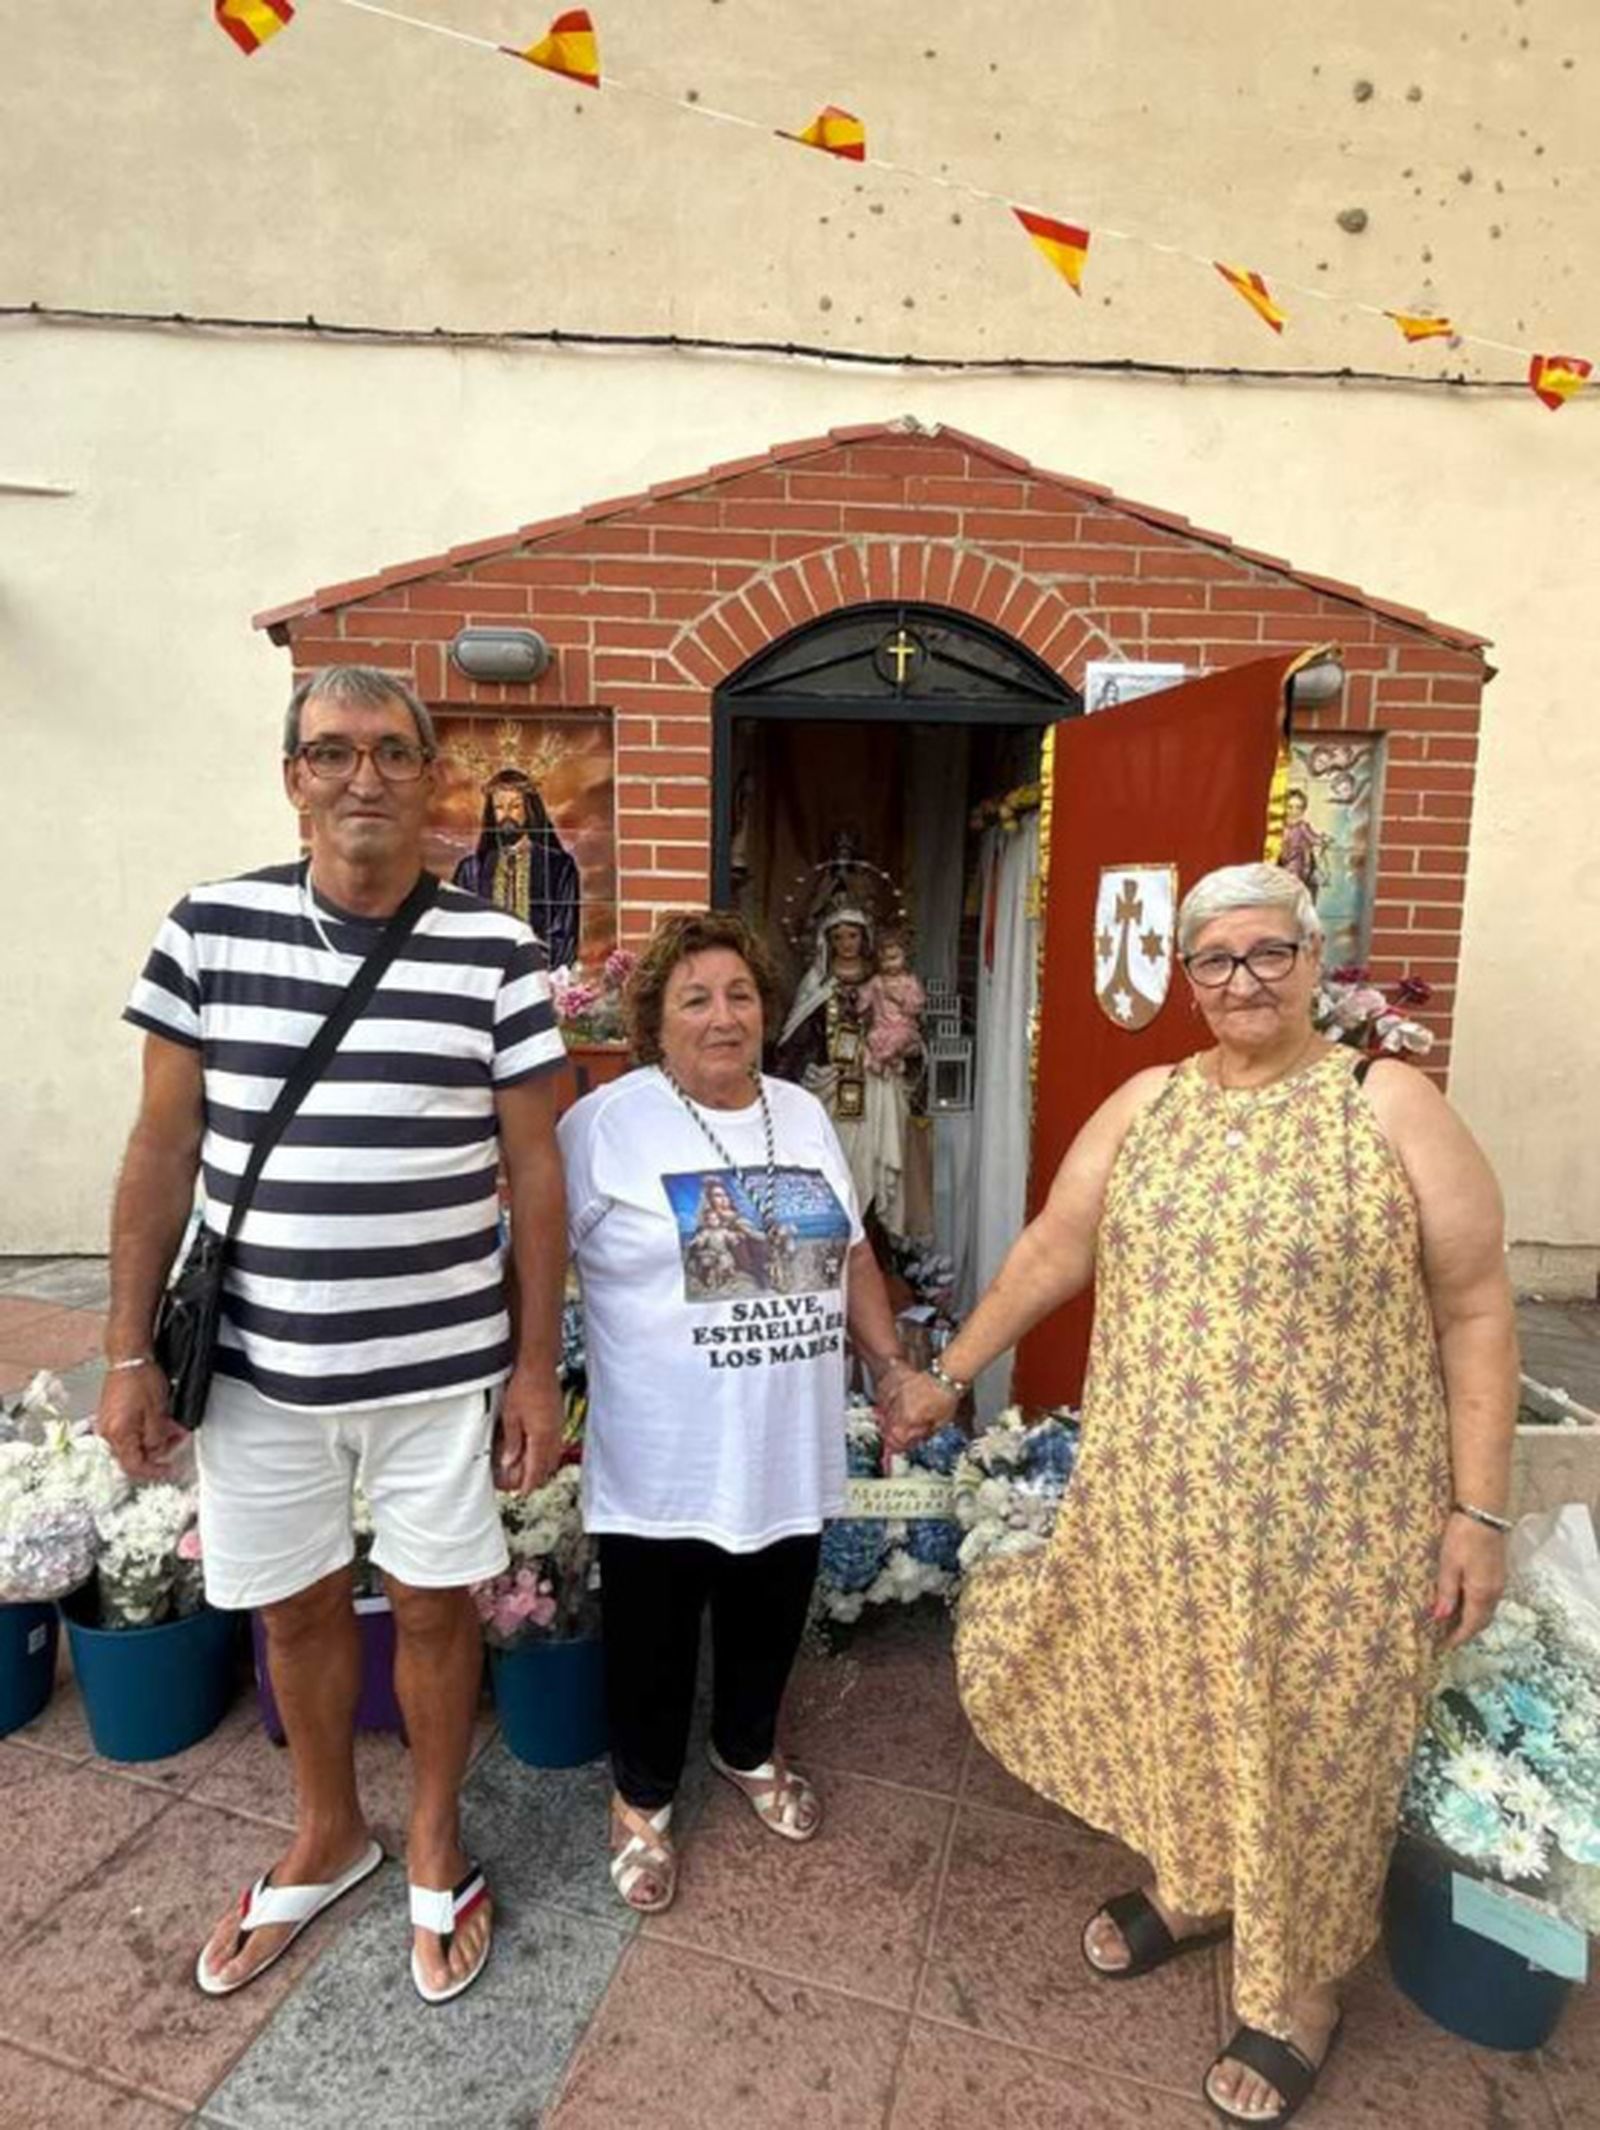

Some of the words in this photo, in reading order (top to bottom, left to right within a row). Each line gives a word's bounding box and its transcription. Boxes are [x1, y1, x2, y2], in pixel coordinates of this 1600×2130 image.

[732, 1296, 824, 1322] SALVE,
[692, 1317, 821, 1345] ESTRELLA
[709, 1348, 763, 1369] LOS
